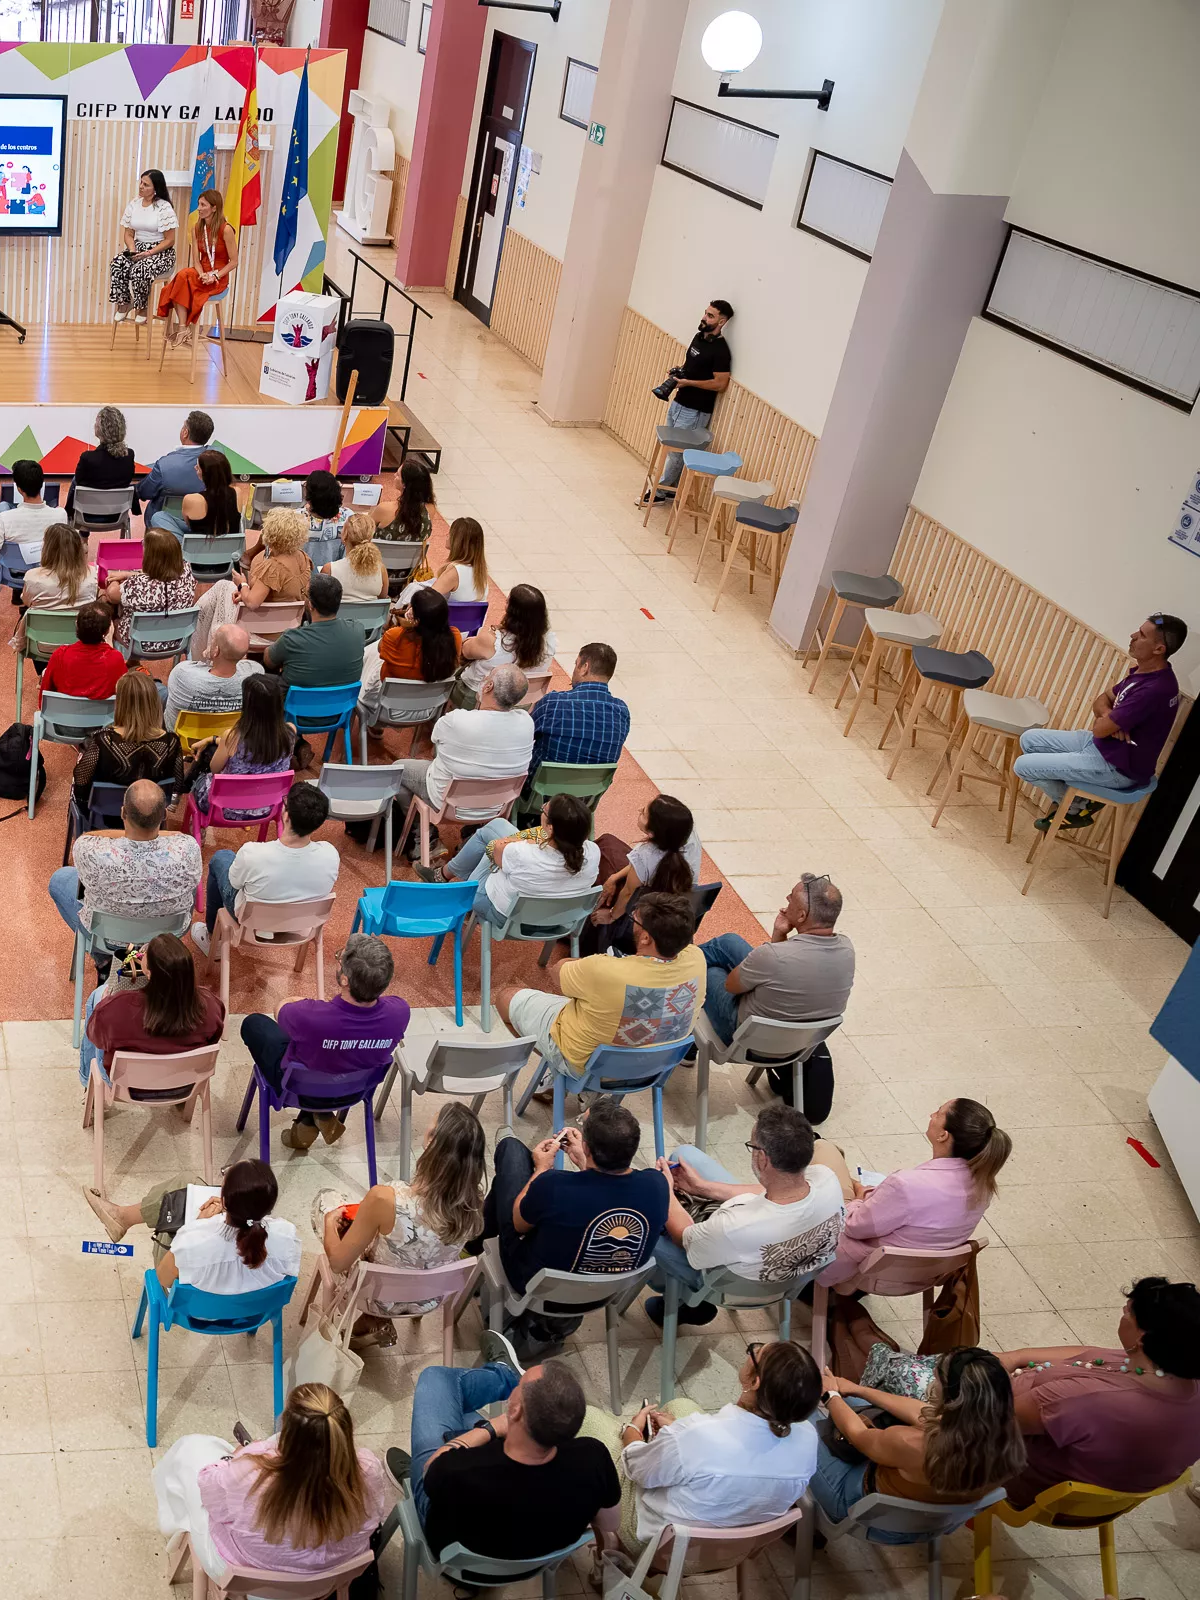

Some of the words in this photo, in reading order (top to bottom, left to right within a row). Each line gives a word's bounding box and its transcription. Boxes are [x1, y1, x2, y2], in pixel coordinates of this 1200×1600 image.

[76, 103, 117, 118] CIFP
[124, 104, 173, 119] TONY
[179, 105, 274, 122] GALAO
[289, 312, 299, 320] TONY
[322, 1038, 339, 1050] CIFP
[340, 1039, 359, 1050] TONY
[358, 1038, 394, 1050] GALLARDO
